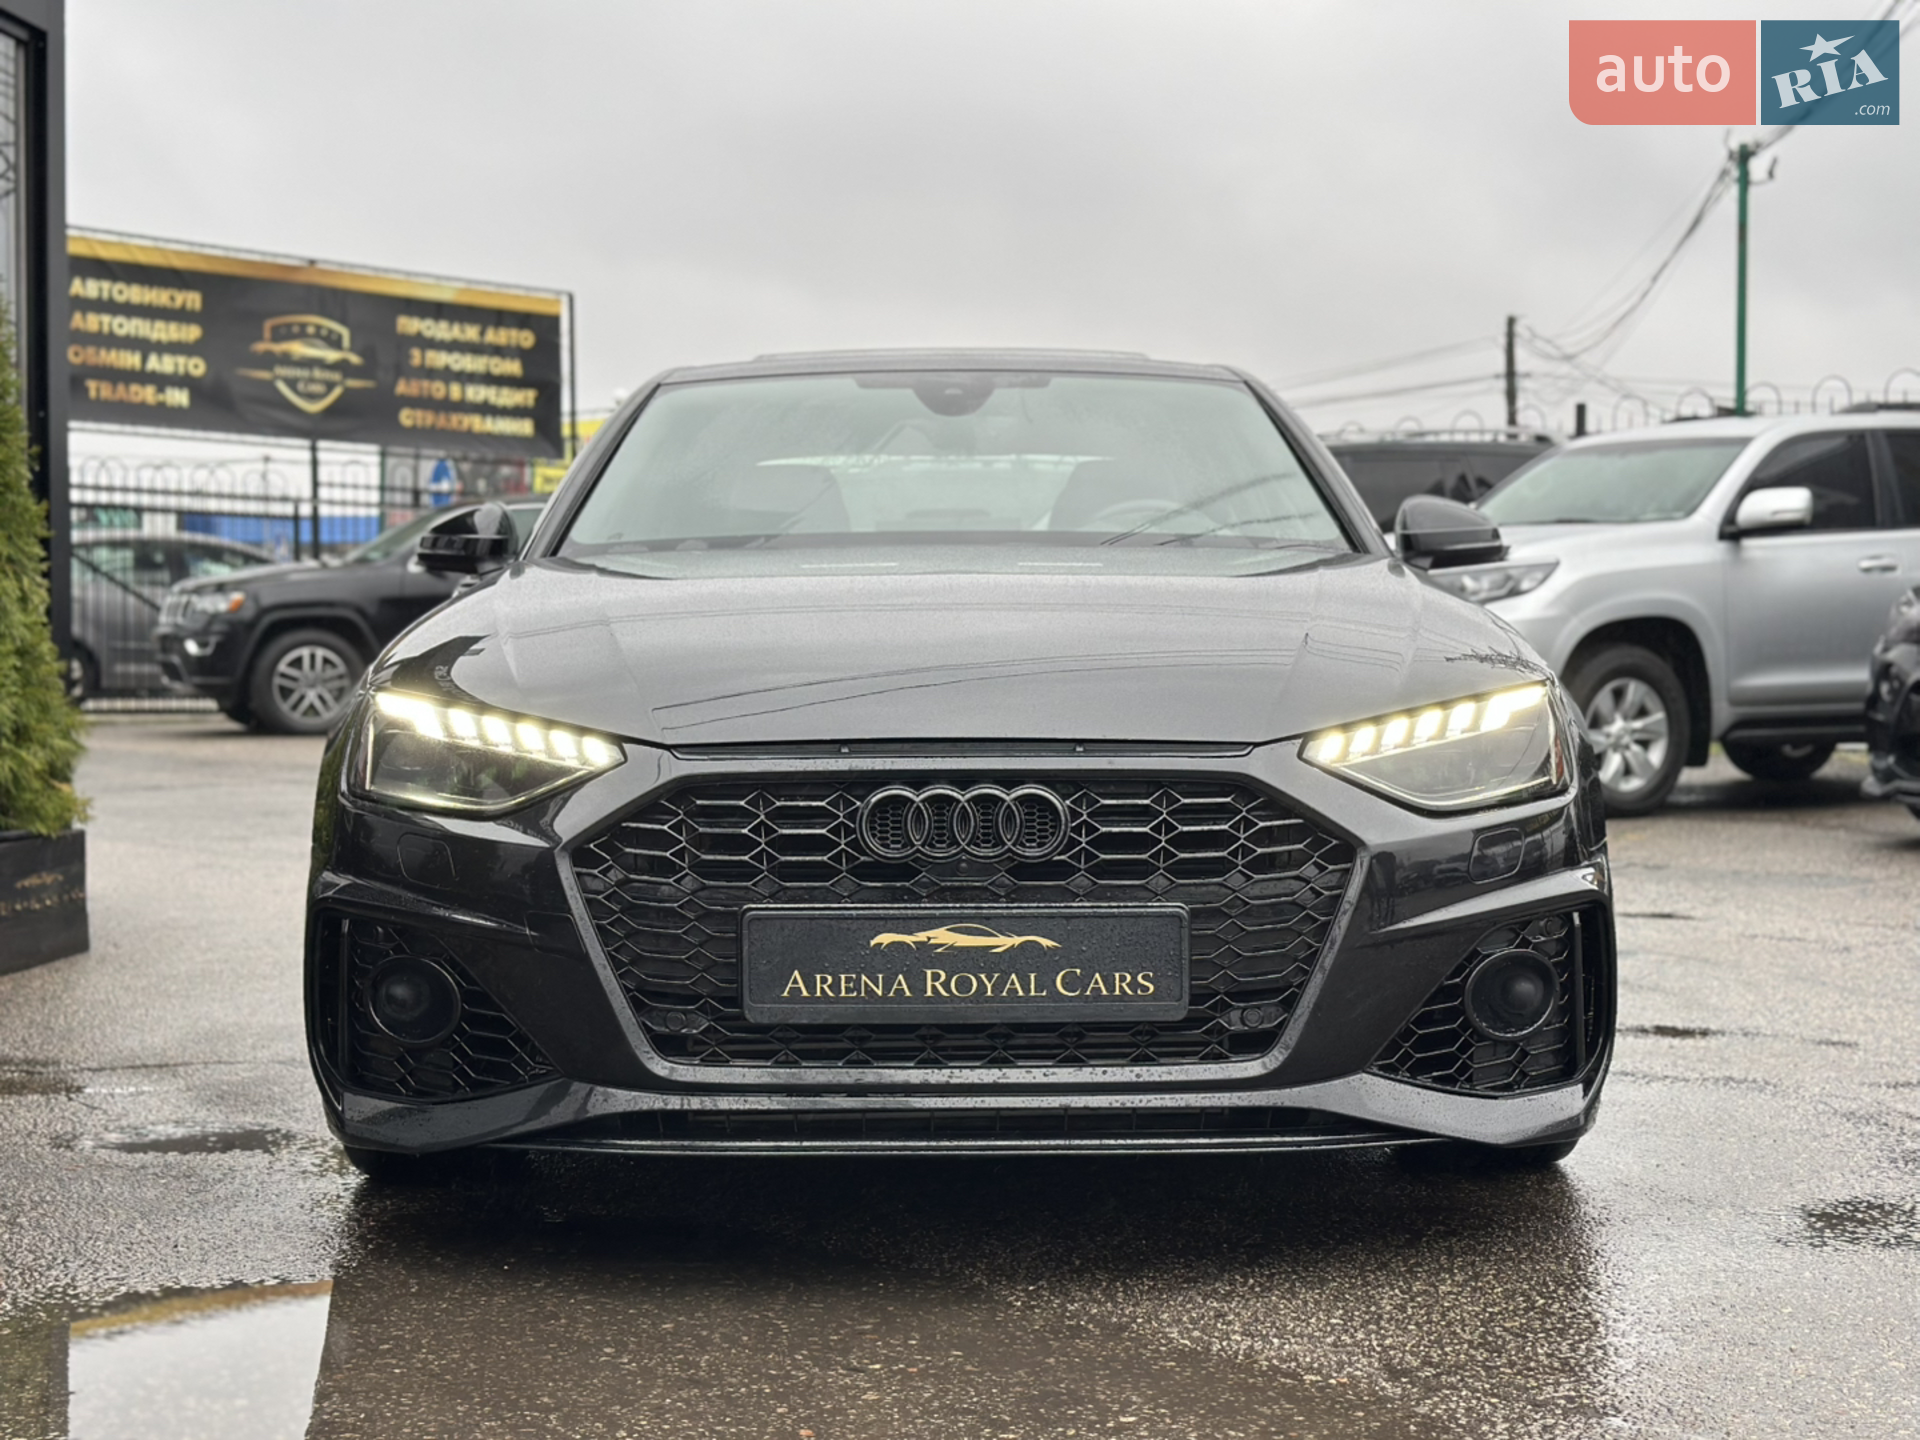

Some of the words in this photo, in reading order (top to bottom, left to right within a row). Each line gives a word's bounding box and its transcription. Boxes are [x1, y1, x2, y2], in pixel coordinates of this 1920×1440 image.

[69, 277, 203, 311] АВТОВИКУП
[70, 311, 203, 343] АВТОПІДБІР
[396, 316, 482, 343] ПРОДАЖ
[484, 326, 536, 349] АВТО
[67, 345, 142, 371] ОБМІН
[145, 351, 206, 377] АВТО
[85, 379, 191, 408] TRADE-IN
[395, 378, 447, 400] АВТО
[464, 385, 538, 408] КРЕДИТ
[398, 407, 535, 437] СТРАХУВАННЯ
[781, 969, 913, 998] ARENA
[923, 968, 1047, 998] ROYAL
[1055, 968, 1155, 997] CARS
